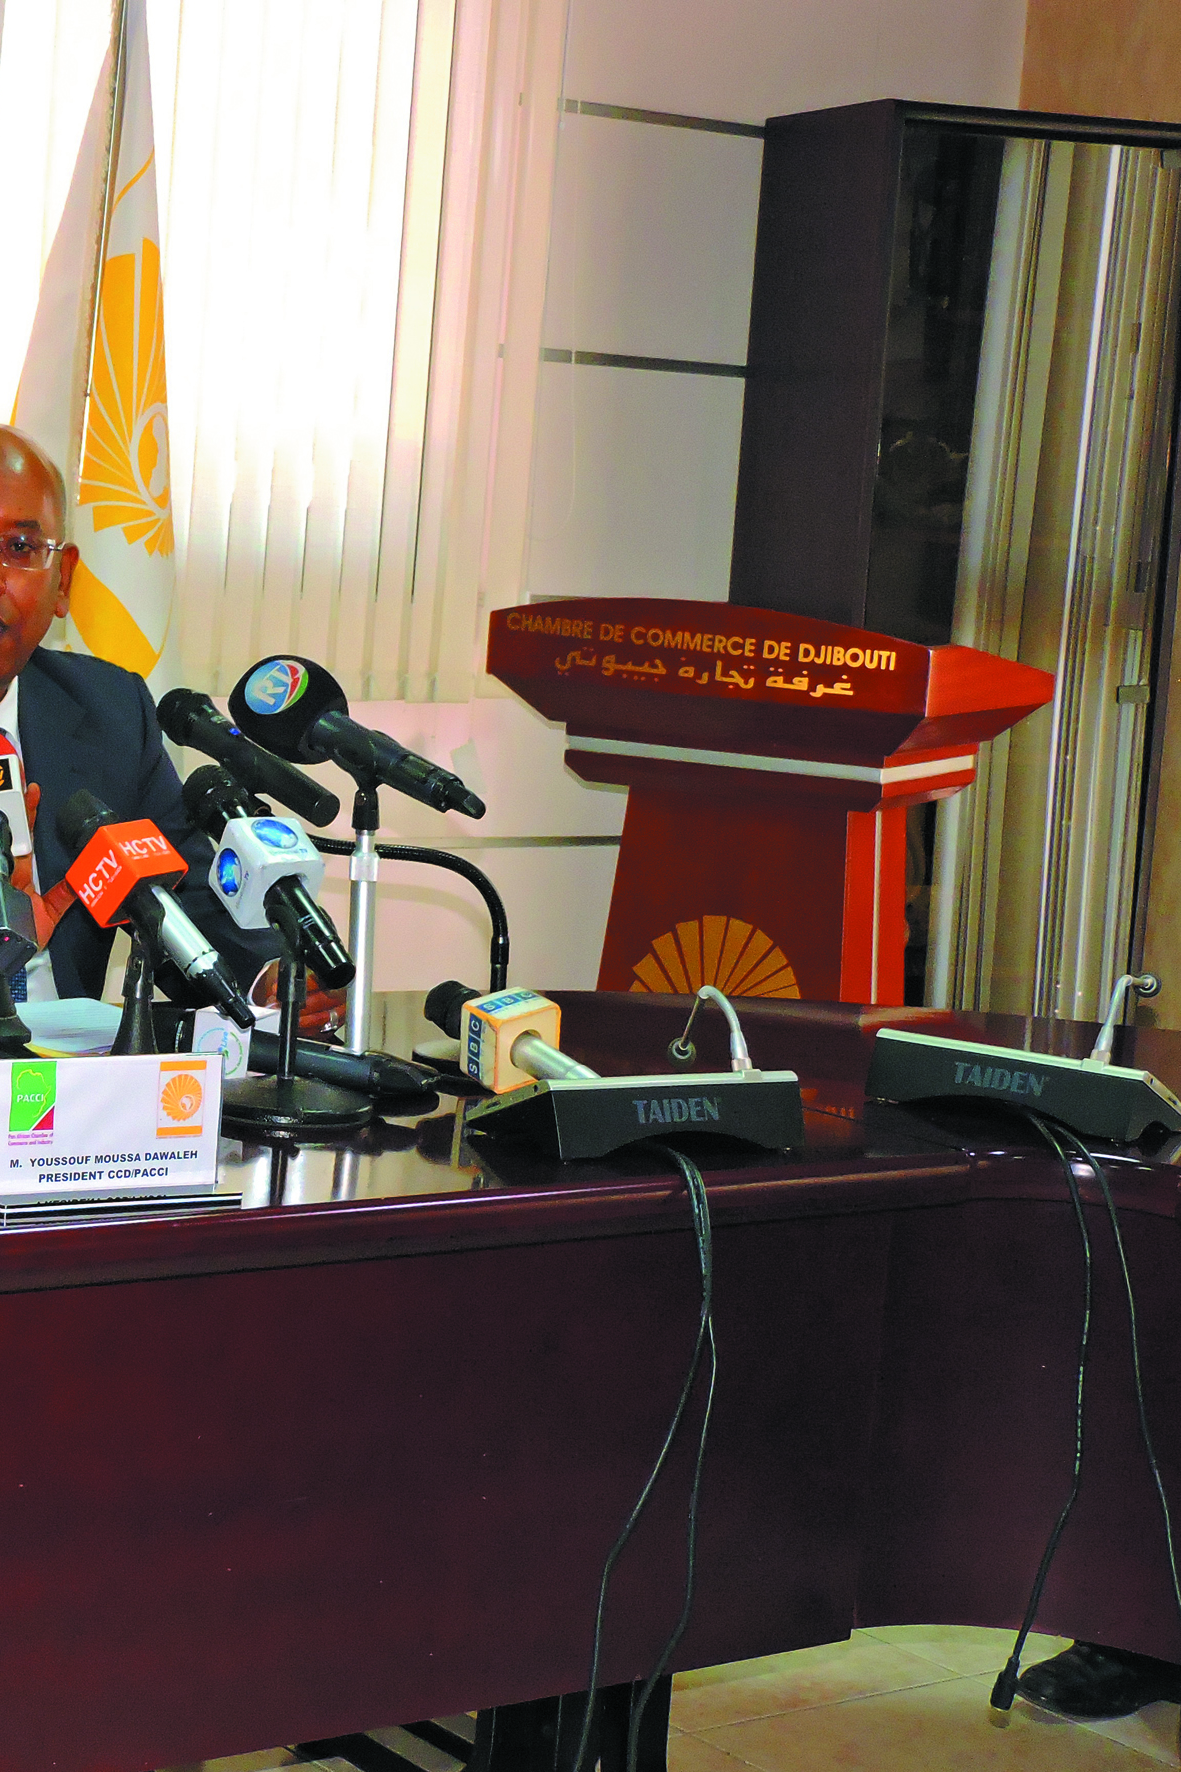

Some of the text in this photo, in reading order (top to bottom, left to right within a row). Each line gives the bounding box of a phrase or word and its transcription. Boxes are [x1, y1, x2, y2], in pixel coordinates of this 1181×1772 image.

[506, 612, 896, 671] CHAMBRE DE COMMERCE DE DJIBOUTI
[765, 667, 854, 698] غرفة
[119, 835, 168, 857] HCTV
[79, 849, 119, 904] HCTV
[955, 1062, 1045, 1096] TAIDEN
[17, 1094, 44, 1102] PACCI
[632, 1097, 719, 1123] TAIDEN
[9, 1150, 198, 1168] M. YOUSSOUF MOUSSA DAWALEH
[38, 1167, 168, 1183] PRESIDENT CCD/PACCI
